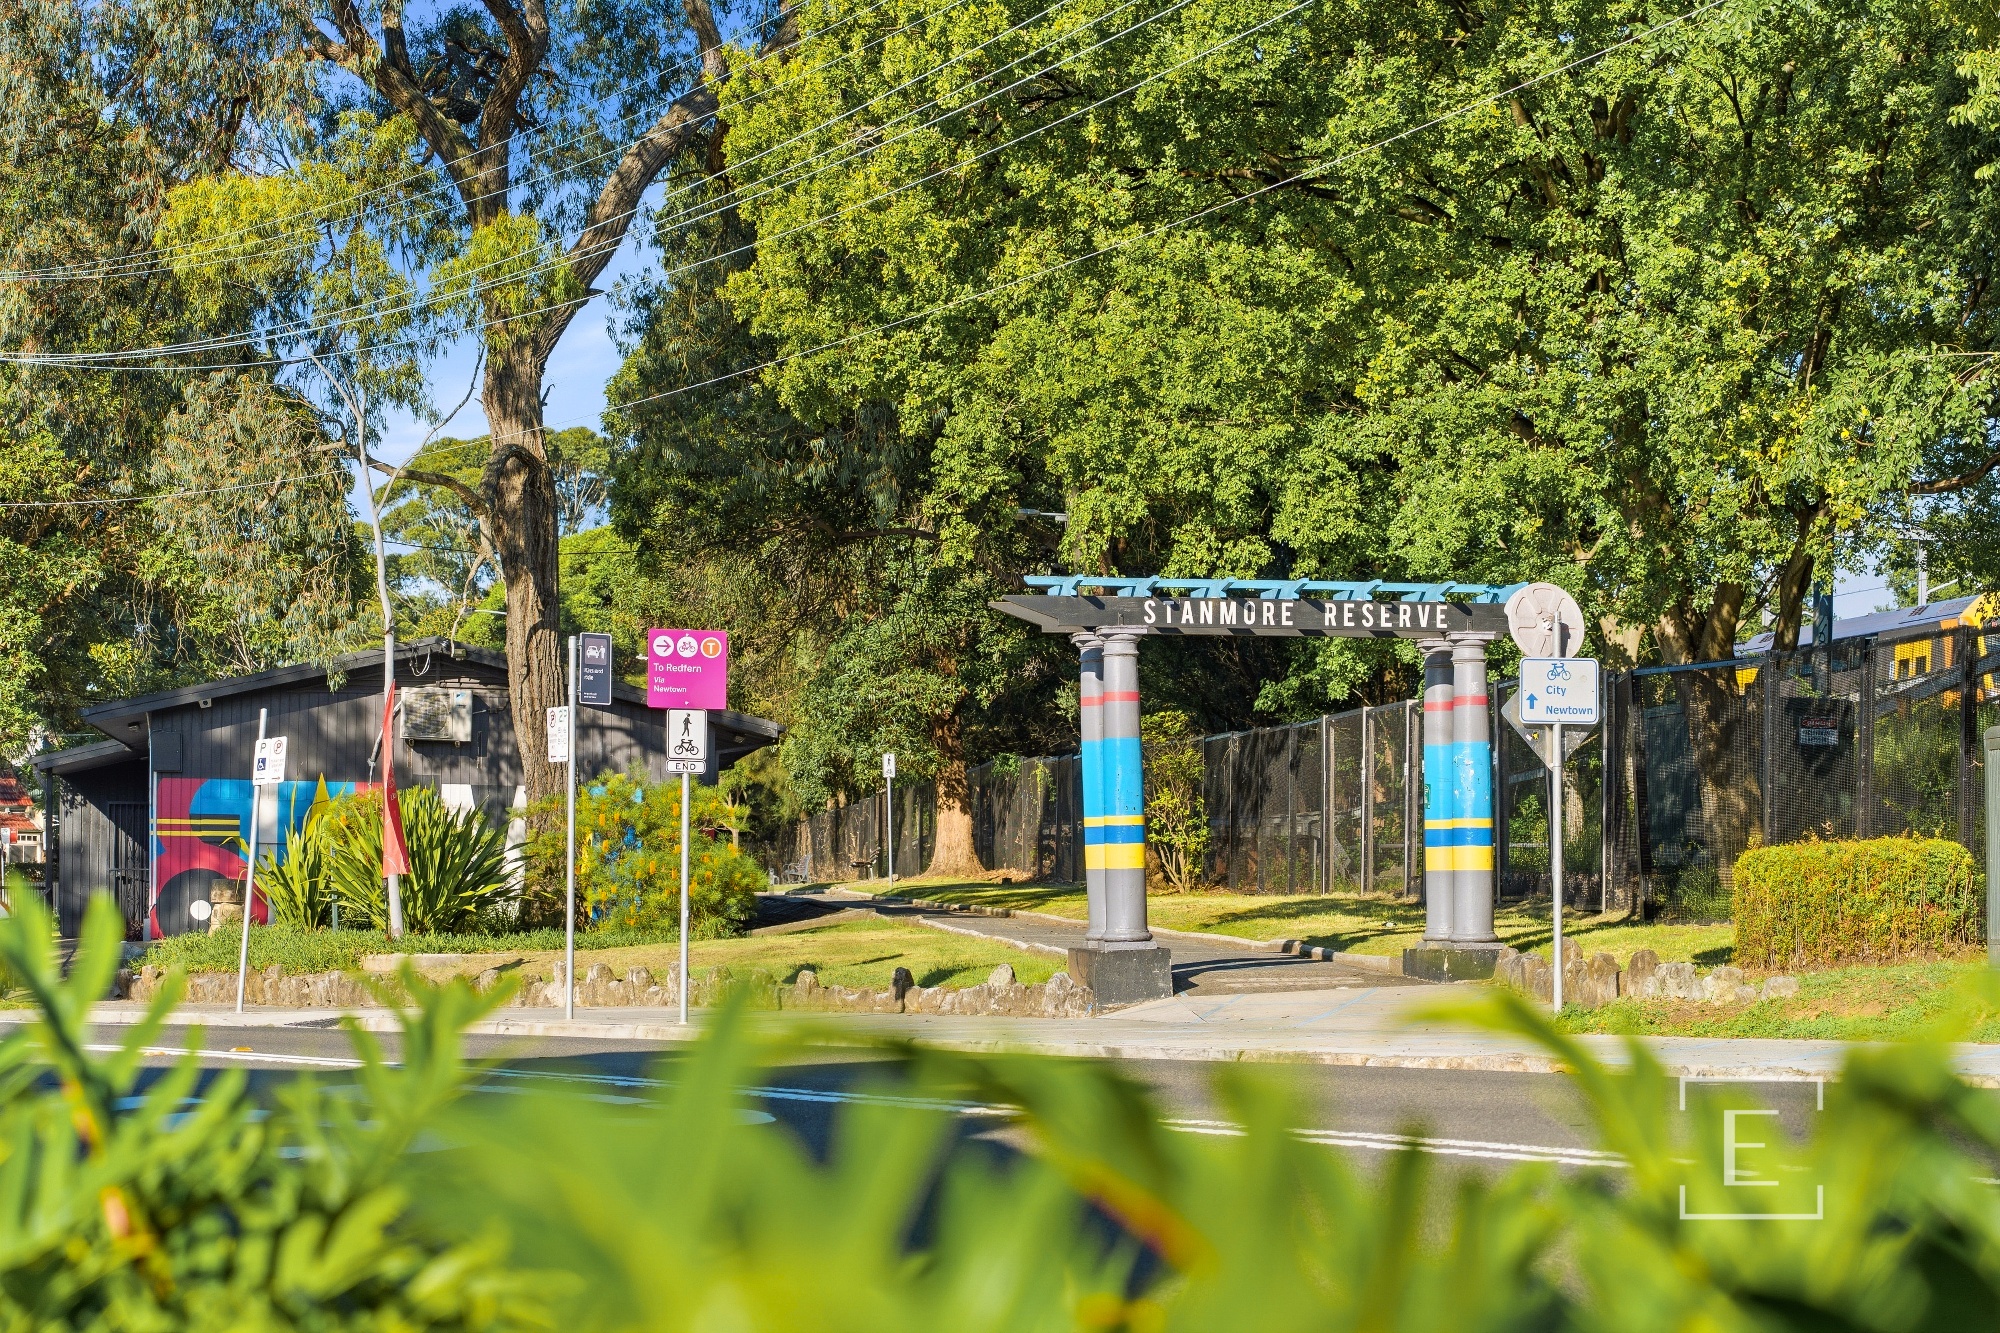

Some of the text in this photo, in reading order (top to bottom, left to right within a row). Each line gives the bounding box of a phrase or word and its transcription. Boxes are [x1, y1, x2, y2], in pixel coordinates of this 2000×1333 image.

[1143, 600, 1449, 629] STANMORE RESERVE
[706, 642, 716, 655] T
[653, 662, 702, 674] To Redfern
[653, 676, 665, 684] Via
[653, 685, 687, 694] Newtown
[1546, 685, 1567, 696] City
[1546, 705, 1593, 715] Newtown
[260, 742, 267, 753] P
[675, 762, 696, 771] END
